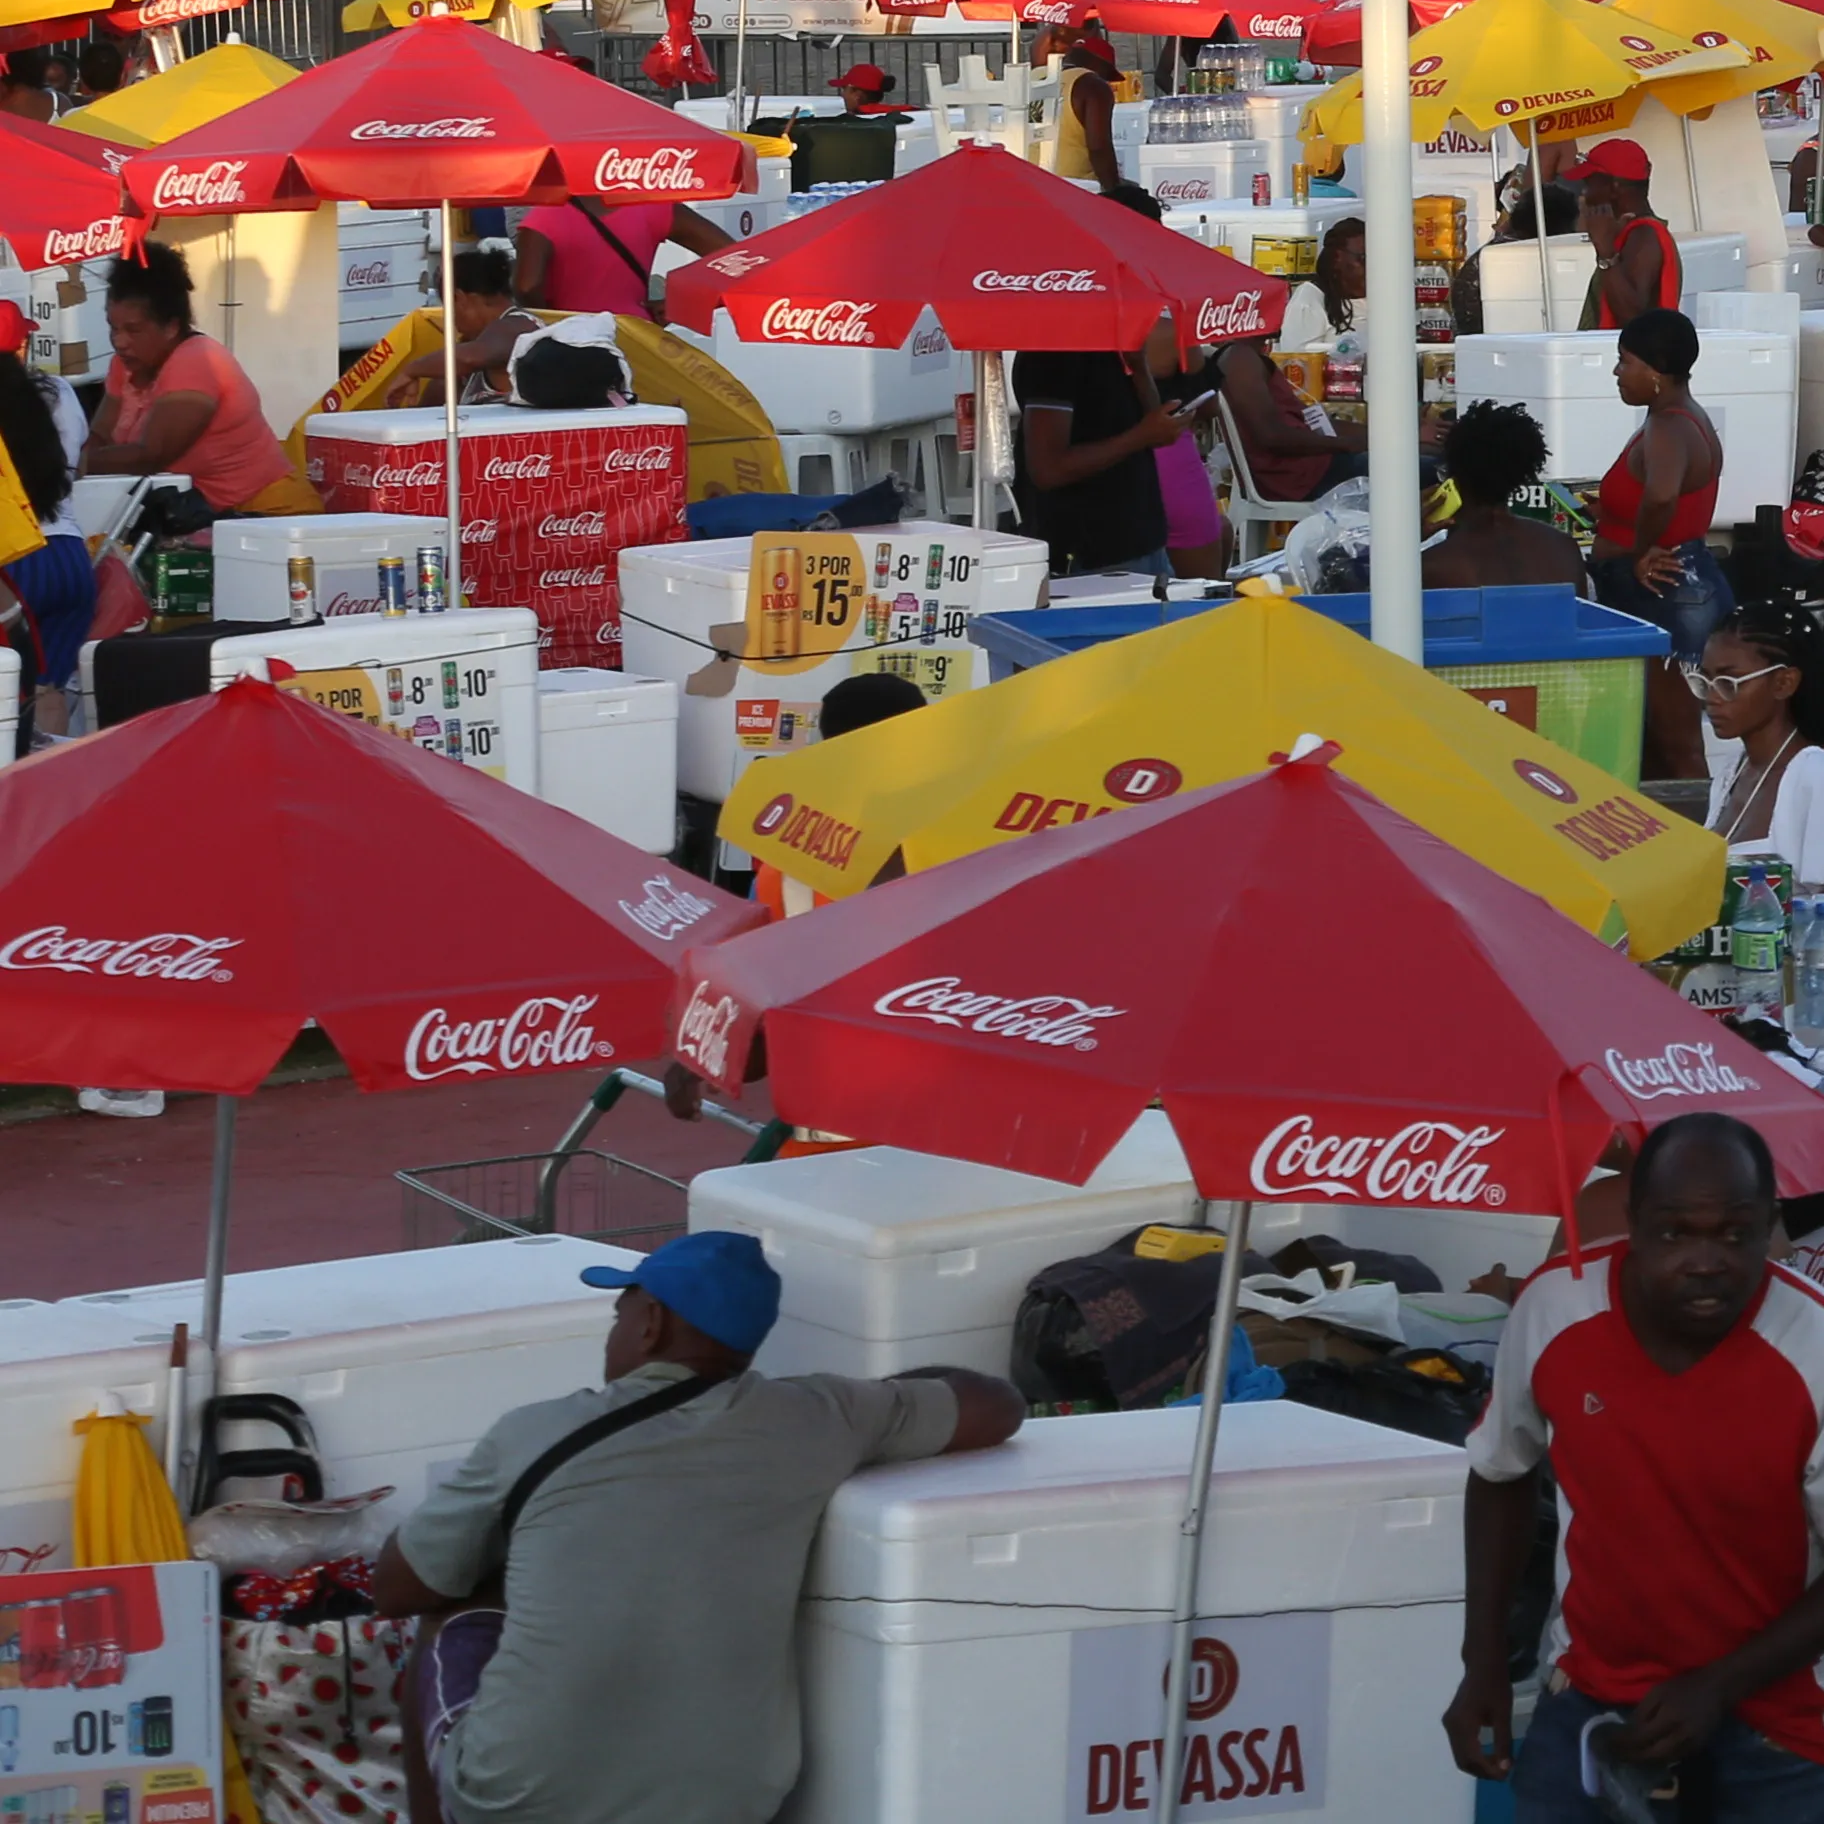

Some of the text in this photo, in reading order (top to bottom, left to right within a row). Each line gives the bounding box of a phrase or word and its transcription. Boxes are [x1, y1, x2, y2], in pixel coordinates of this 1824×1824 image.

[1249, 13, 1303, 38] Coca-Cola
[1522, 89, 1595, 110] DEVASSA
[1557, 102, 1615, 131] DEVASSA
[350, 117, 486, 141] Coca-Cola
[154, 161, 248, 209] Coca-Cola
[595, 147, 698, 192] Coca-Cola
[1156, 178, 1212, 200] Coca-Cola
[45, 216, 123, 265] Coca-Cola
[346, 261, 390, 286] Coca-Cola
[973, 269, 1098, 294] Coca-Cola
[762, 297, 878, 343] Coca-Cola
[1196, 289, 1262, 340] Coca-Cola
[340, 337, 395, 396] DEVASSA
[373, 460, 445, 487] Coca-Cola
[485, 453, 551, 481] Coca-Cola
[605, 445, 673, 472] Coca-Cola
[538, 511, 606, 538] Coca-Cola
[539, 564, 605, 589] Coca-Cola
[805, 556, 850, 576] 3 POR
[781, 804, 862, 872] DEVASSA
[1554, 796, 1669, 862] DEVASSA
[0, 925, 245, 982] Coca-Cola
[874, 976, 1128, 1048] Coca-Cola
[406, 994, 599, 1081] Coca-Cola
[1605, 1041, 1745, 1101] Coca-Cola
[1250, 1114, 1506, 1205] Coca-Cola
